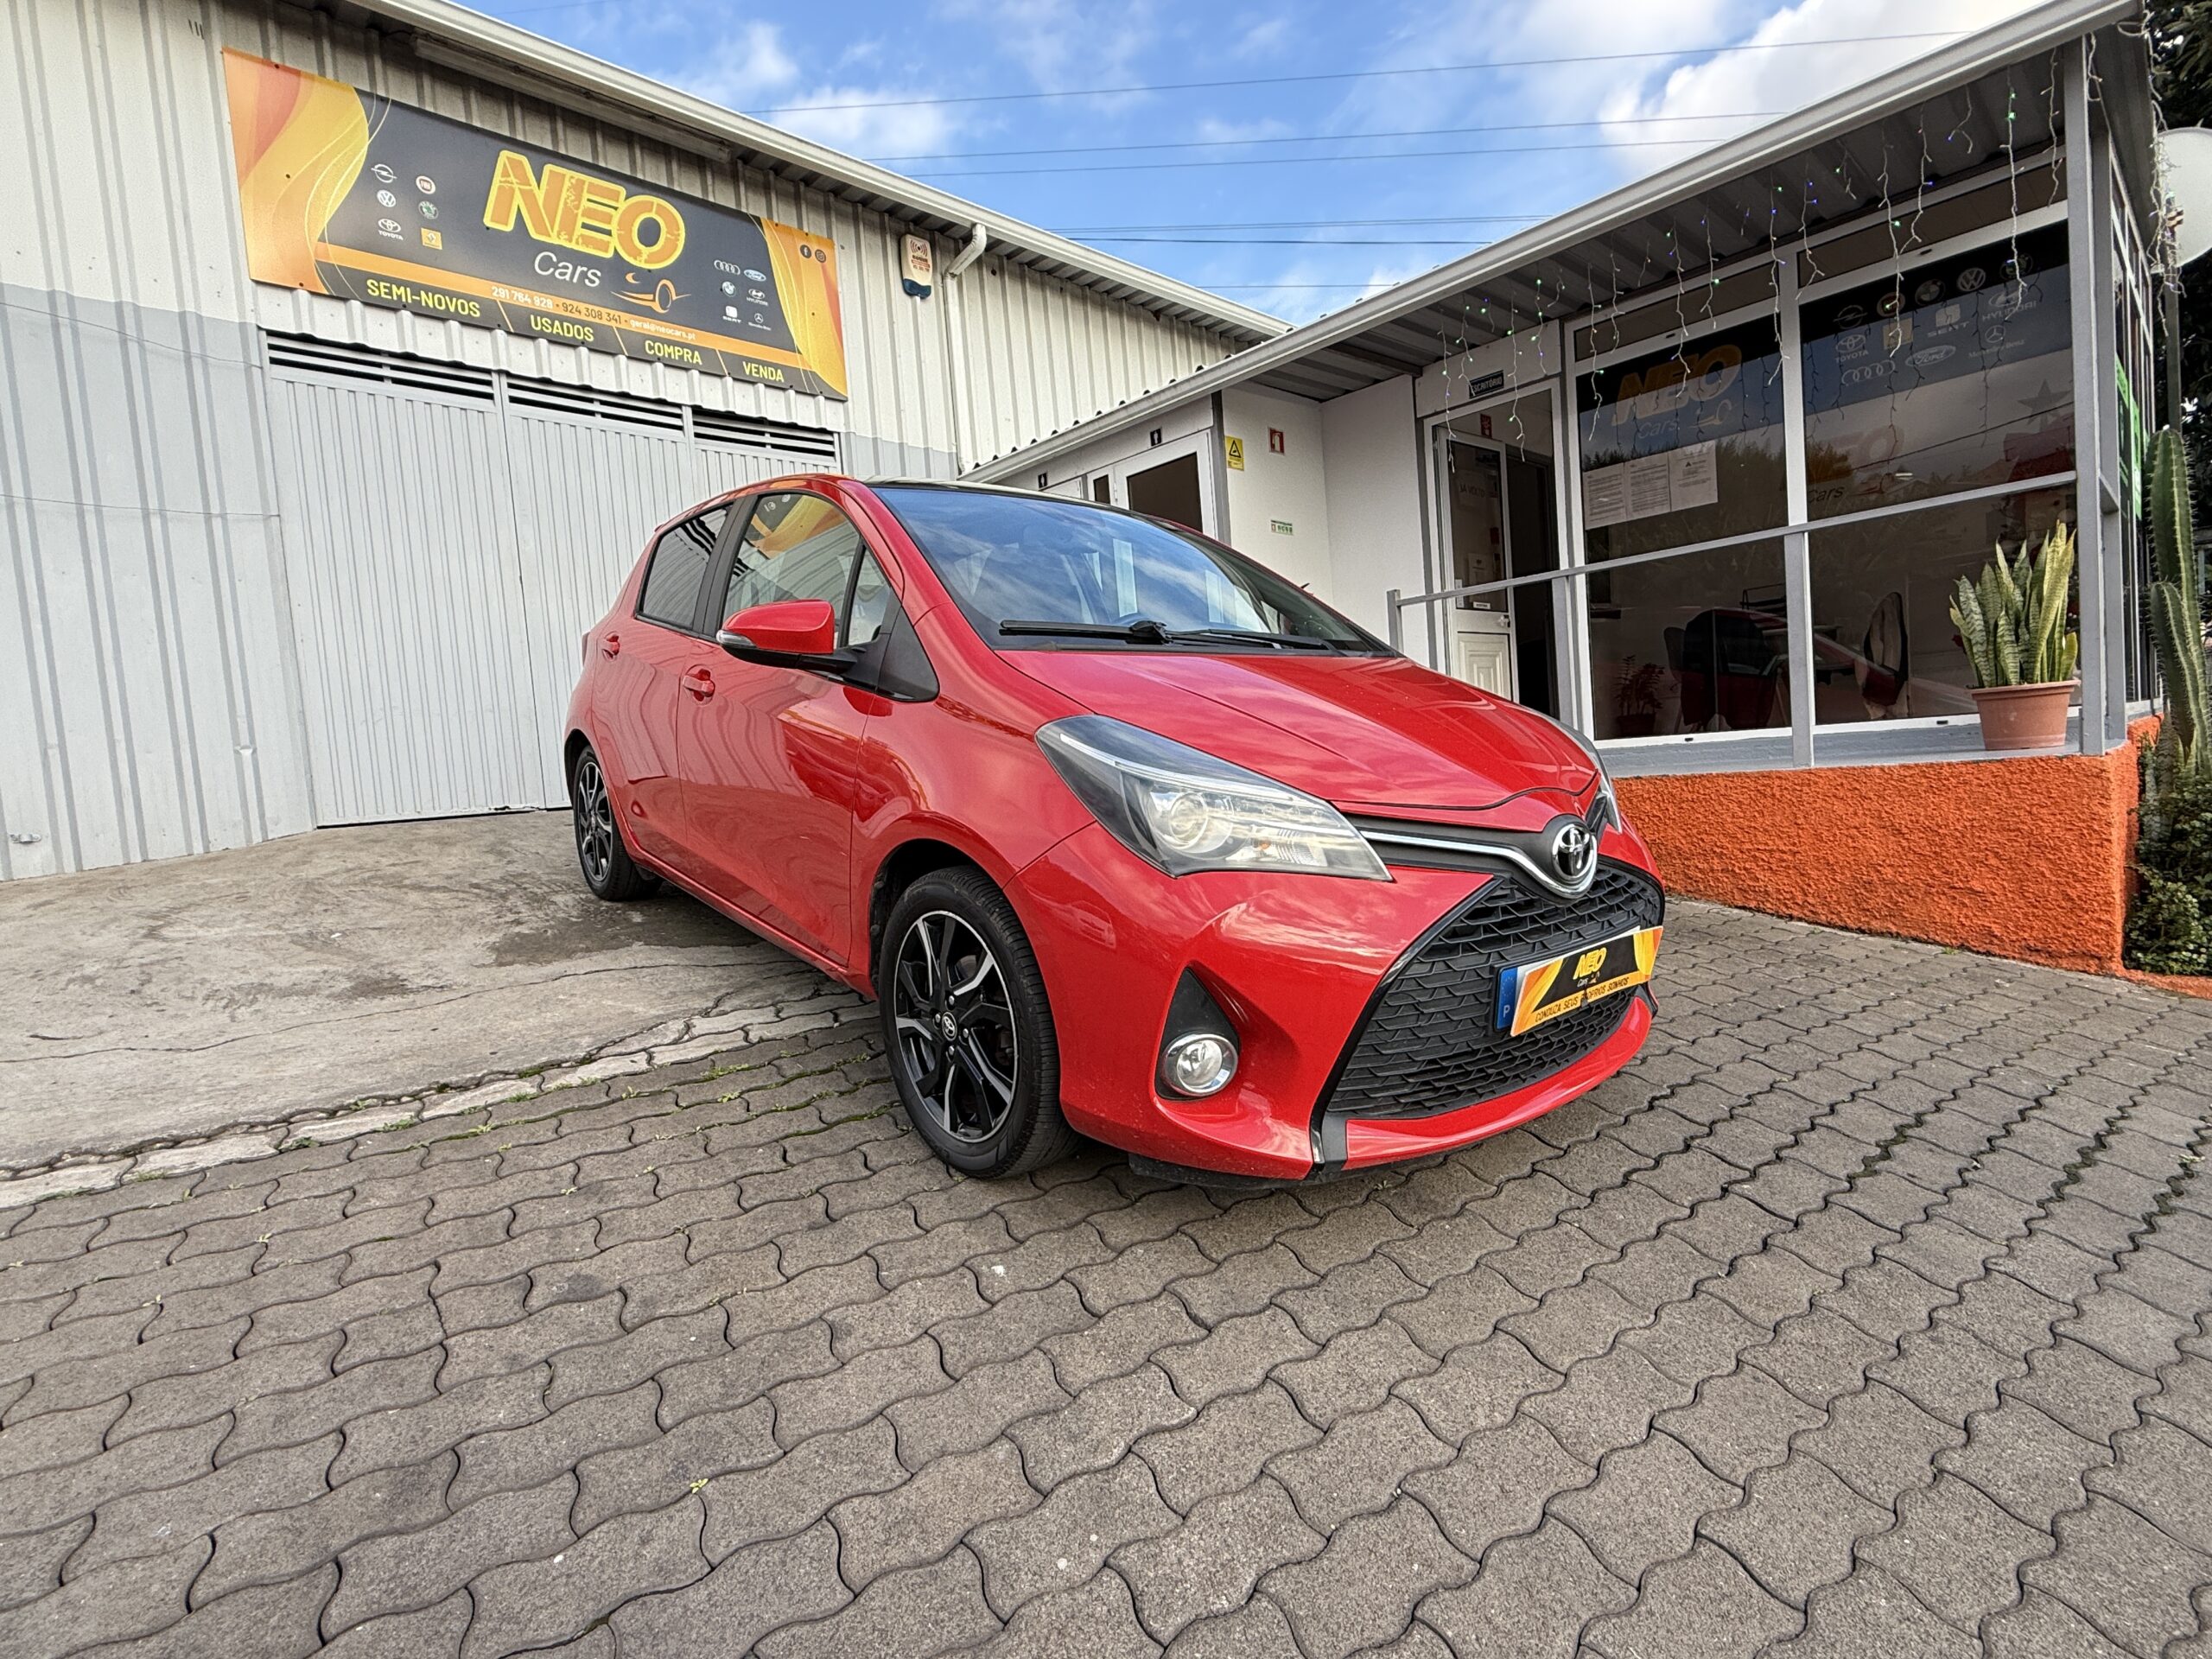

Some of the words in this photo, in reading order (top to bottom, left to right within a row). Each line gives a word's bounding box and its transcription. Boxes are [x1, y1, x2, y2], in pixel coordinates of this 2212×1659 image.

[483, 149, 685, 270] NEO
[378, 230, 404, 240] TOYOTA
[534, 251, 601, 288] Cars
[366, 278, 480, 318] SEMI-NOVOS
[530, 315, 594, 342] USADOS
[562, 302, 582, 315] 924
[584, 307, 603, 321] 308
[606, 312, 621, 324] 341
[630, 319, 696, 340] geral@neocars.pt
[1928, 321, 1969, 338] SEAT
[645, 340, 702, 365] COMPRA
[1834, 349, 1869, 364] TOYOTA
[742, 360, 785, 383] VENDA
[1611, 344, 1742, 426] NEO
[1638, 419, 1678, 439] Cars
[1573, 947, 1607, 980] NEO
[1503, 1005, 1510, 1018] P
[1535, 1004, 1560, 1022] CONDUZA
[1563, 996, 1579, 1010] SEUS
